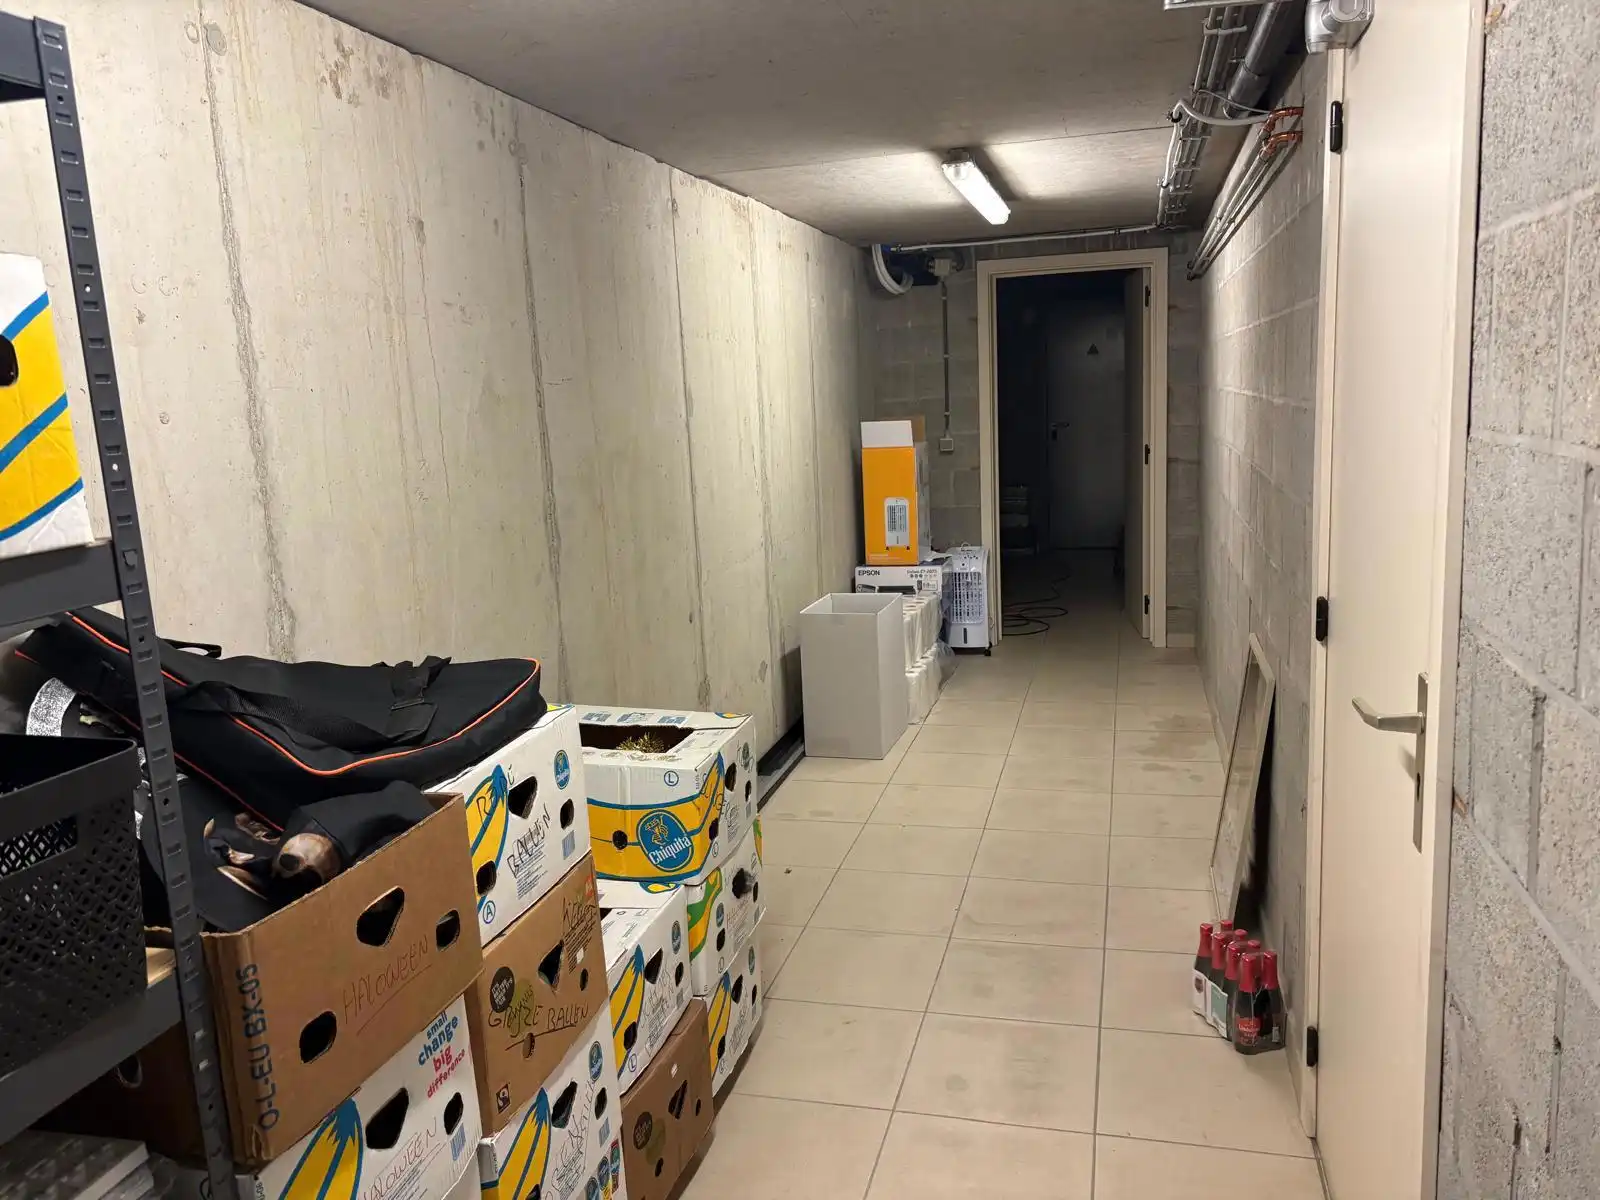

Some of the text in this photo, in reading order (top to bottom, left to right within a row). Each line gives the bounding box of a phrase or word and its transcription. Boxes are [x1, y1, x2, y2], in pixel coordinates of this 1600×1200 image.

[649, 836, 692, 865] Chiquita
[343, 934, 428, 1024] HALOWEEN
[235, 963, 267, 1038] BX-05
[547, 1000, 589, 1030] BALLEN
[418, 1016, 458, 1066] change
[426, 1009, 448, 1039] small
[427, 1048, 465, 1098] difference
[433, 1045, 453, 1072] big
